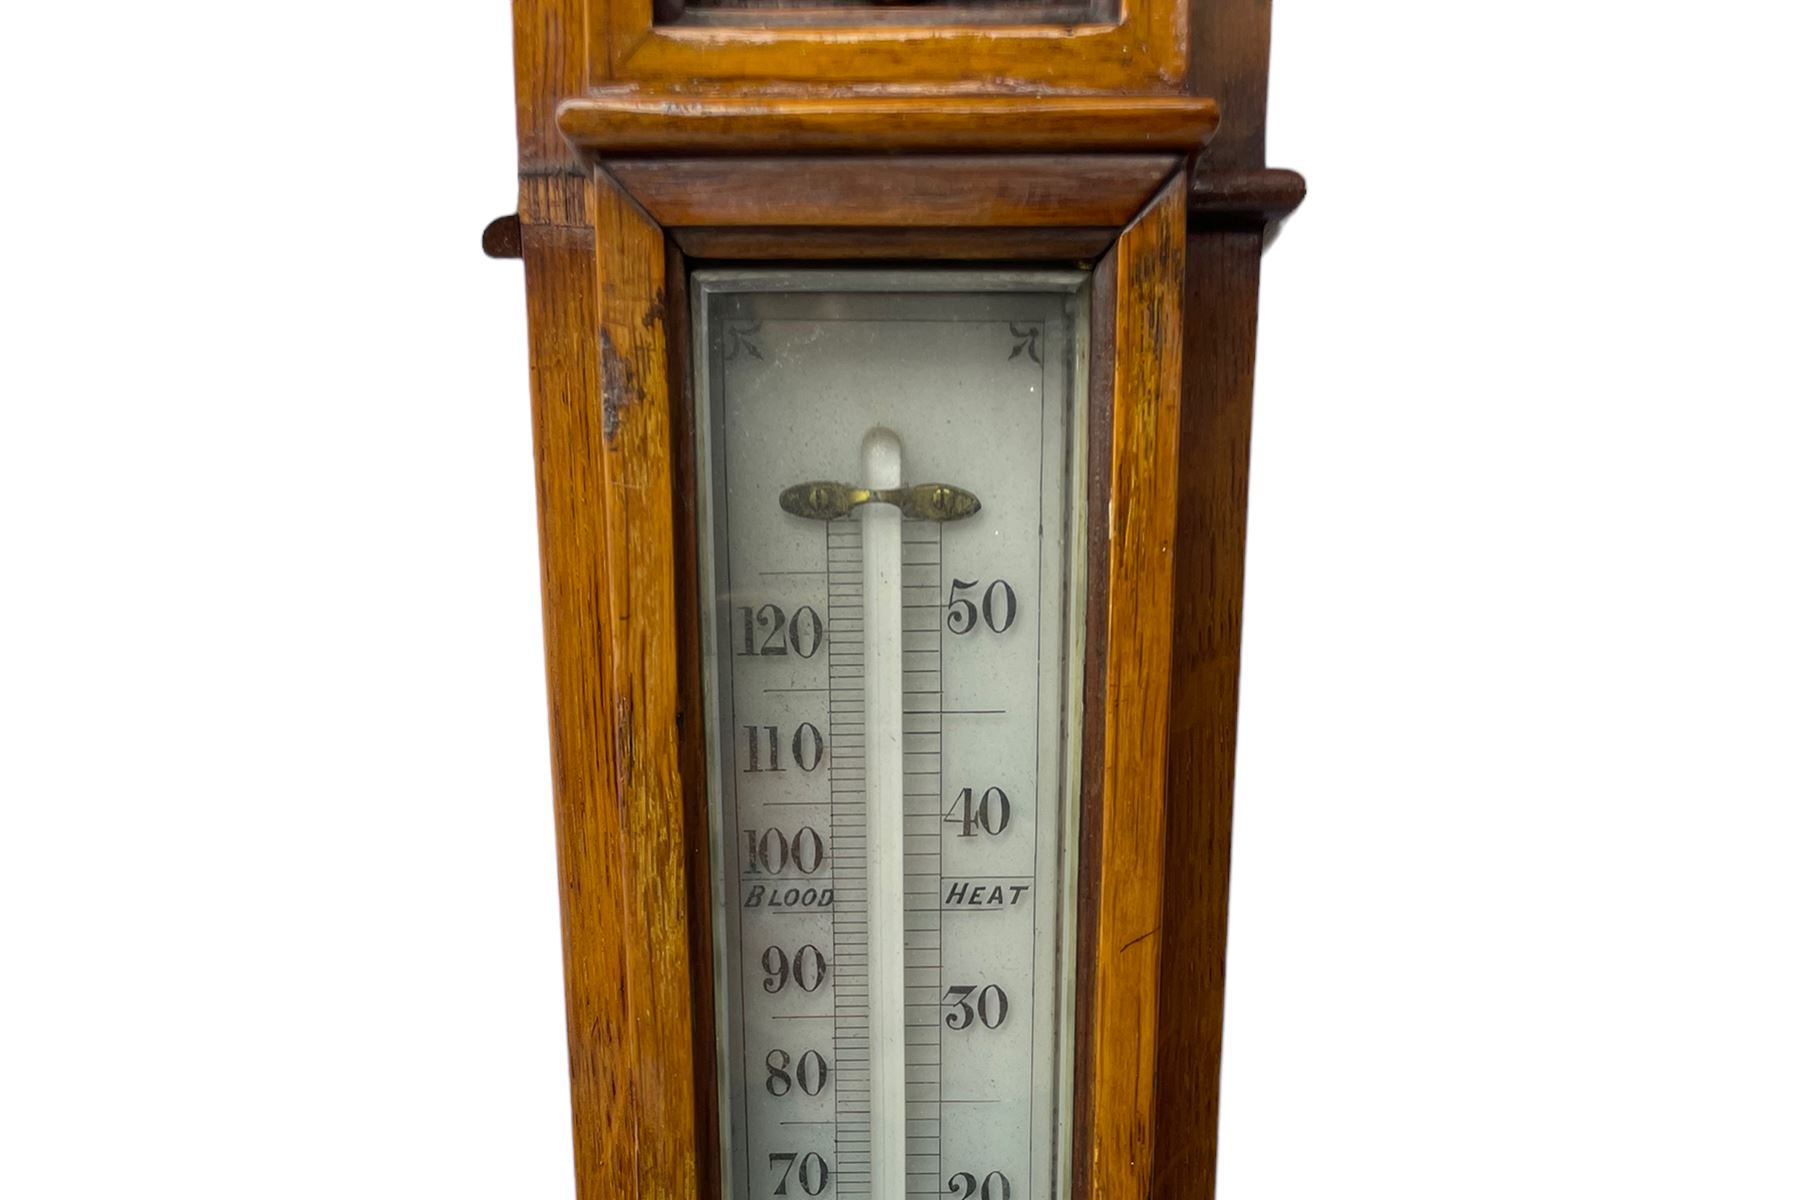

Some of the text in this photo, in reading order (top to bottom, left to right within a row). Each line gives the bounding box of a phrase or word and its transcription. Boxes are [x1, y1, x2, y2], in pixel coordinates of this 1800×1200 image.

[737, 604, 823, 658] 120
[948, 579, 1016, 634] 50
[743, 722, 824, 772] 110
[943, 786, 1011, 837] 40
[743, 826, 824, 875] 100
[744, 883, 1030, 908] BLOOD HEAT
[761, 944, 827, 994] 90
[943, 984, 1009, 1030] 30
[765, 1049, 828, 1097] 80
[769, 1152, 829, 1196] 70
